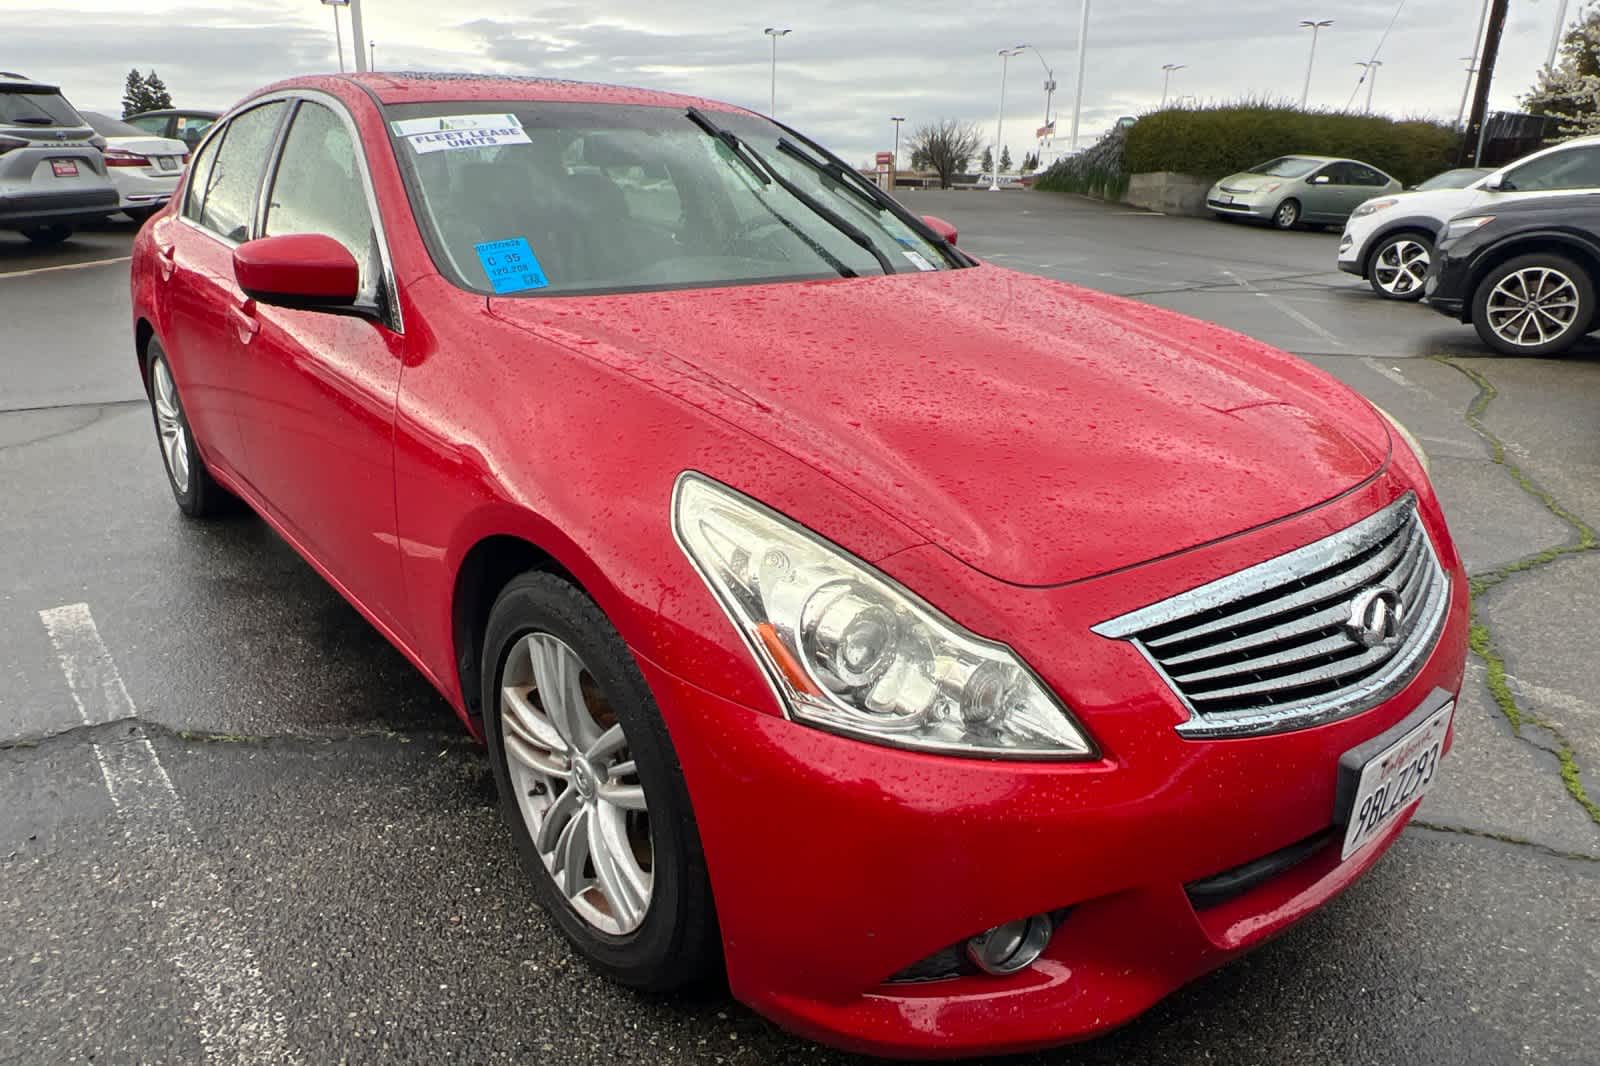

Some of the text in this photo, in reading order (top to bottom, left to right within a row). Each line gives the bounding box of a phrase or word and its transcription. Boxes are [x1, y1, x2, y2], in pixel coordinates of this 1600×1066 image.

[415, 128, 521, 144] FLEET LEASE
[447, 136, 498, 148] UNITS
[504, 253, 521, 263] 35
[1351, 742, 1440, 845] 9BLZ293
